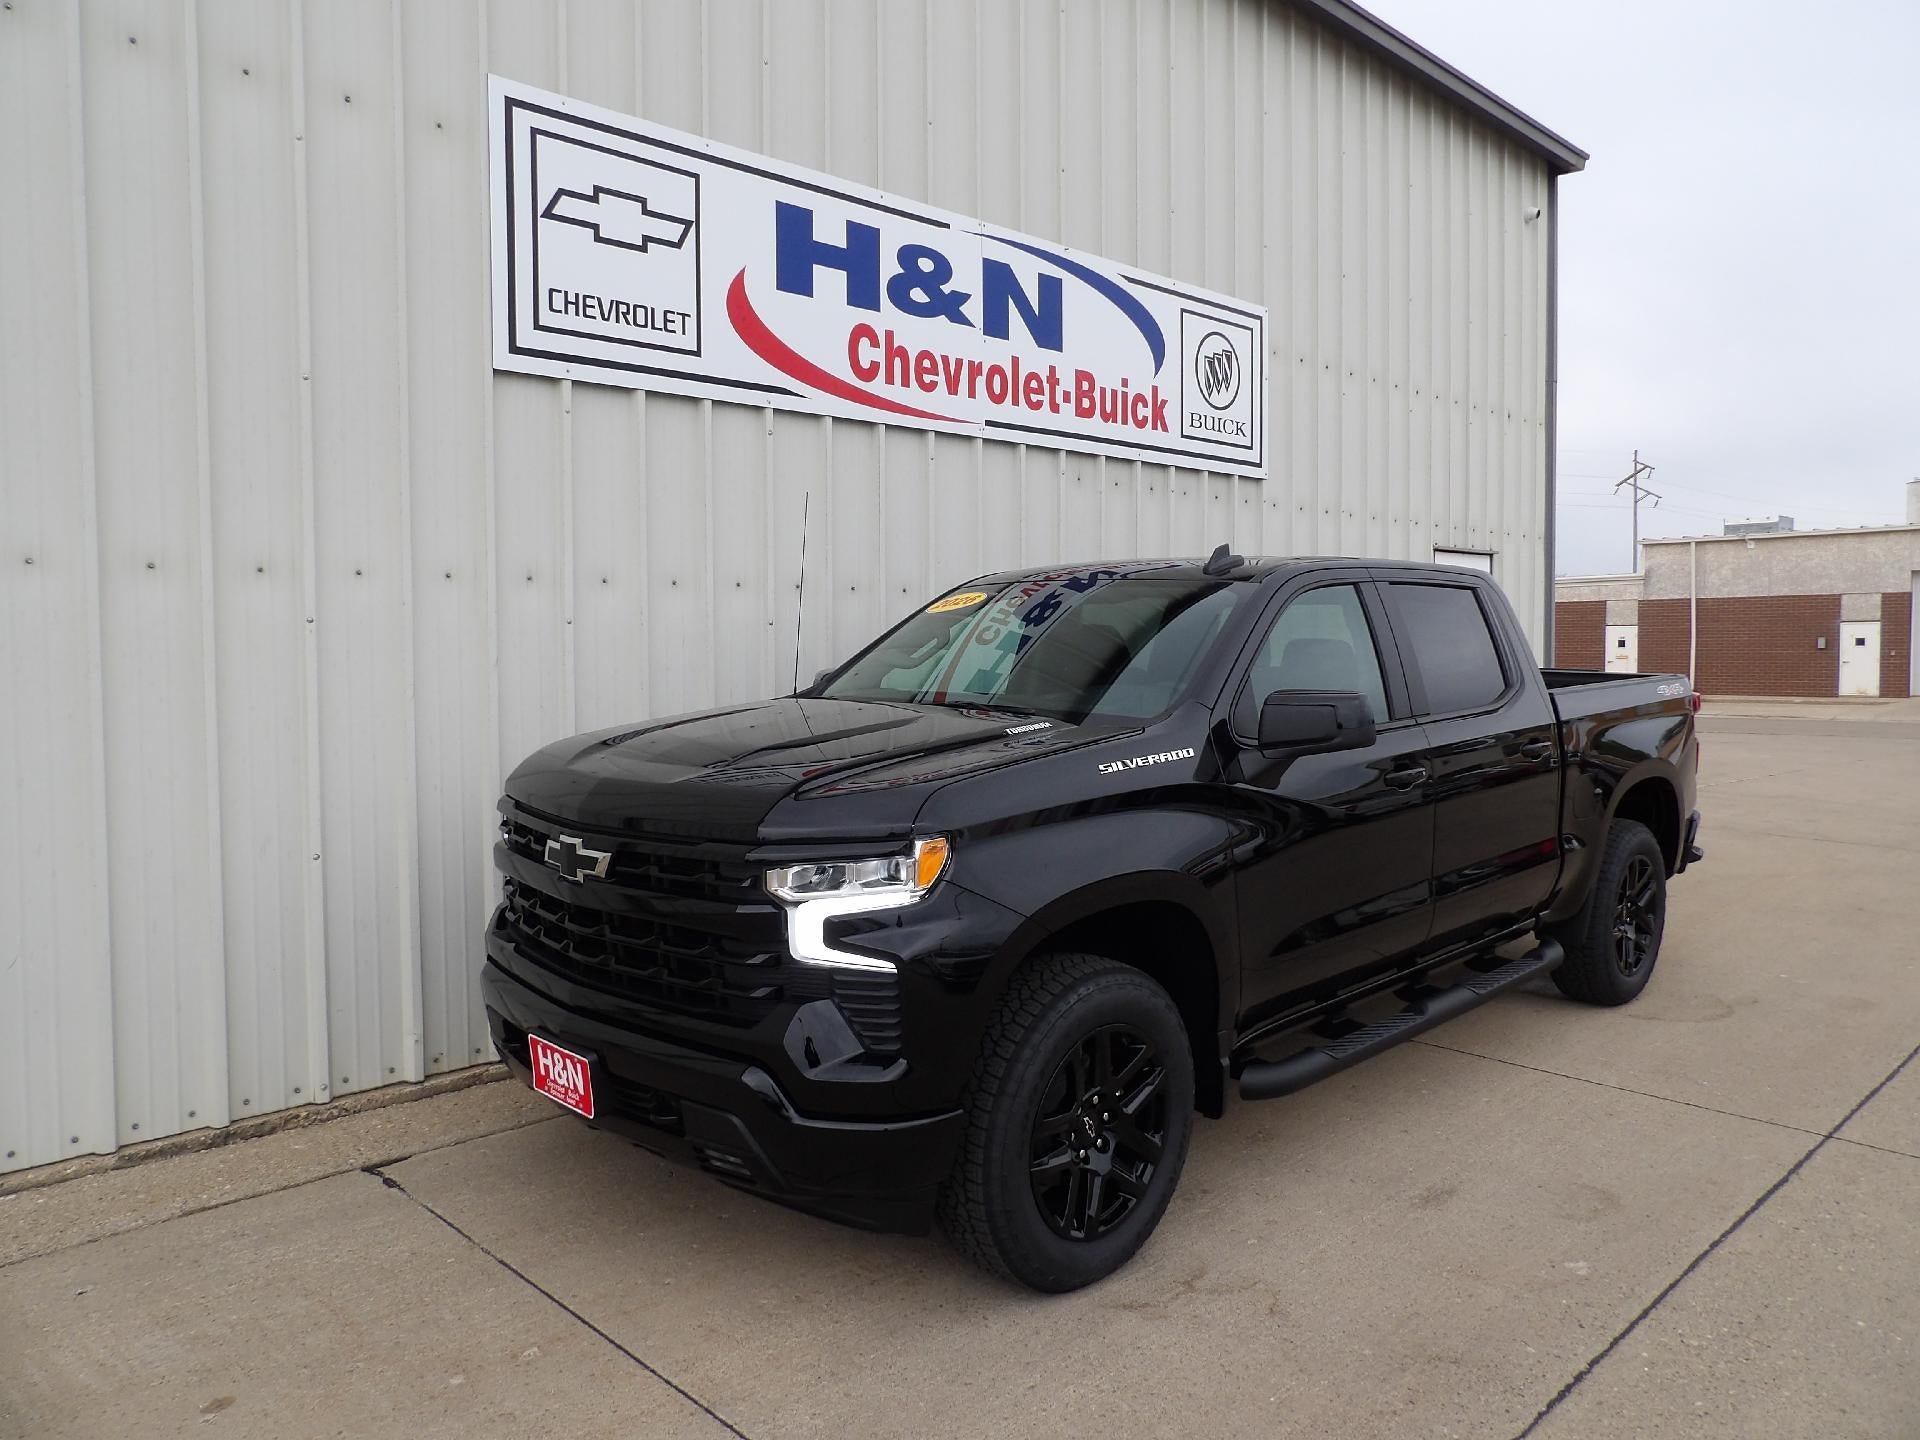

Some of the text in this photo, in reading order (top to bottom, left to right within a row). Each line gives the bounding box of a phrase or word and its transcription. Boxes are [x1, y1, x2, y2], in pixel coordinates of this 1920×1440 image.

[776, 200, 1063, 352] H&N
[547, 286, 692, 336] CHEVROLET
[847, 322, 1170, 434] Chevrolet-Buick
[1188, 411, 1247, 438] BUICK
[1098, 747, 1195, 775] SILVERADO
[537, 1044, 585, 1096] H&N
